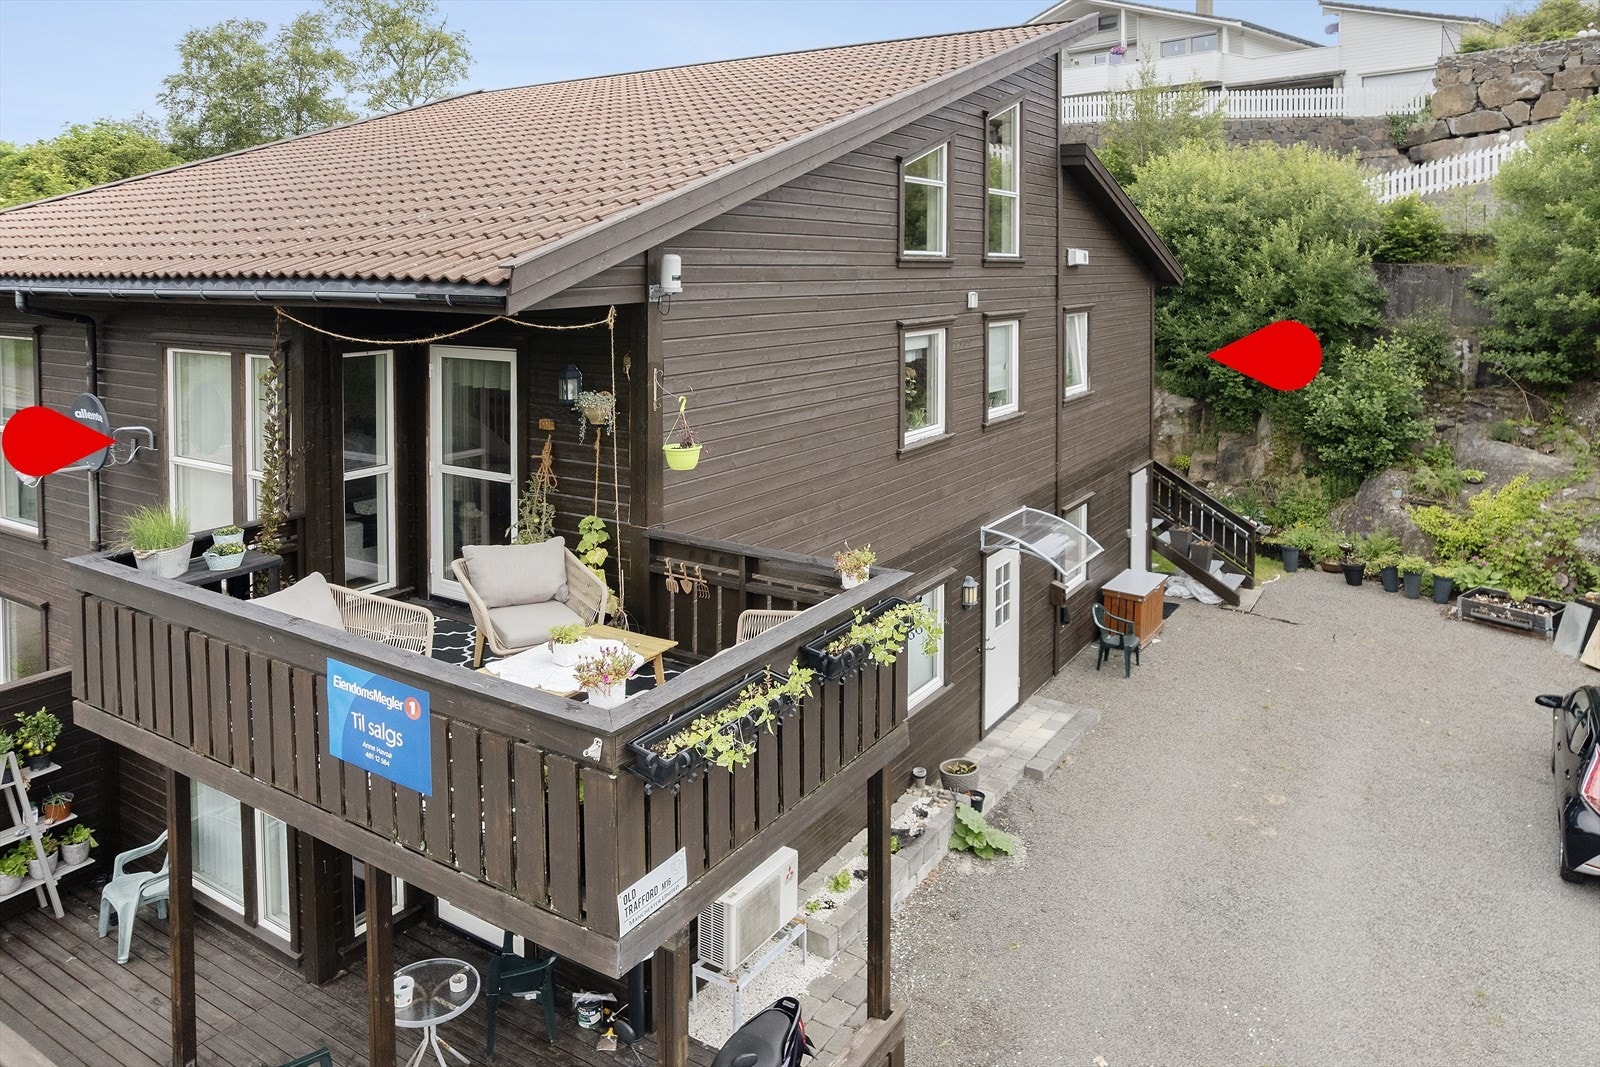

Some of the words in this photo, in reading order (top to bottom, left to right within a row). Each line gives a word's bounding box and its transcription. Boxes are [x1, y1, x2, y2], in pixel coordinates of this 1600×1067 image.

[74, 408, 104, 423] allente
[333, 674, 404, 710] EiendomsMegler
[351, 711, 365, 732] Til
[368, 722, 403, 748] salgs
[362, 741, 376, 752] Anne
[623, 888, 636, 905] OLD
[624, 885, 658, 917] TRAFFORD
[661, 878, 671, 890] M16
